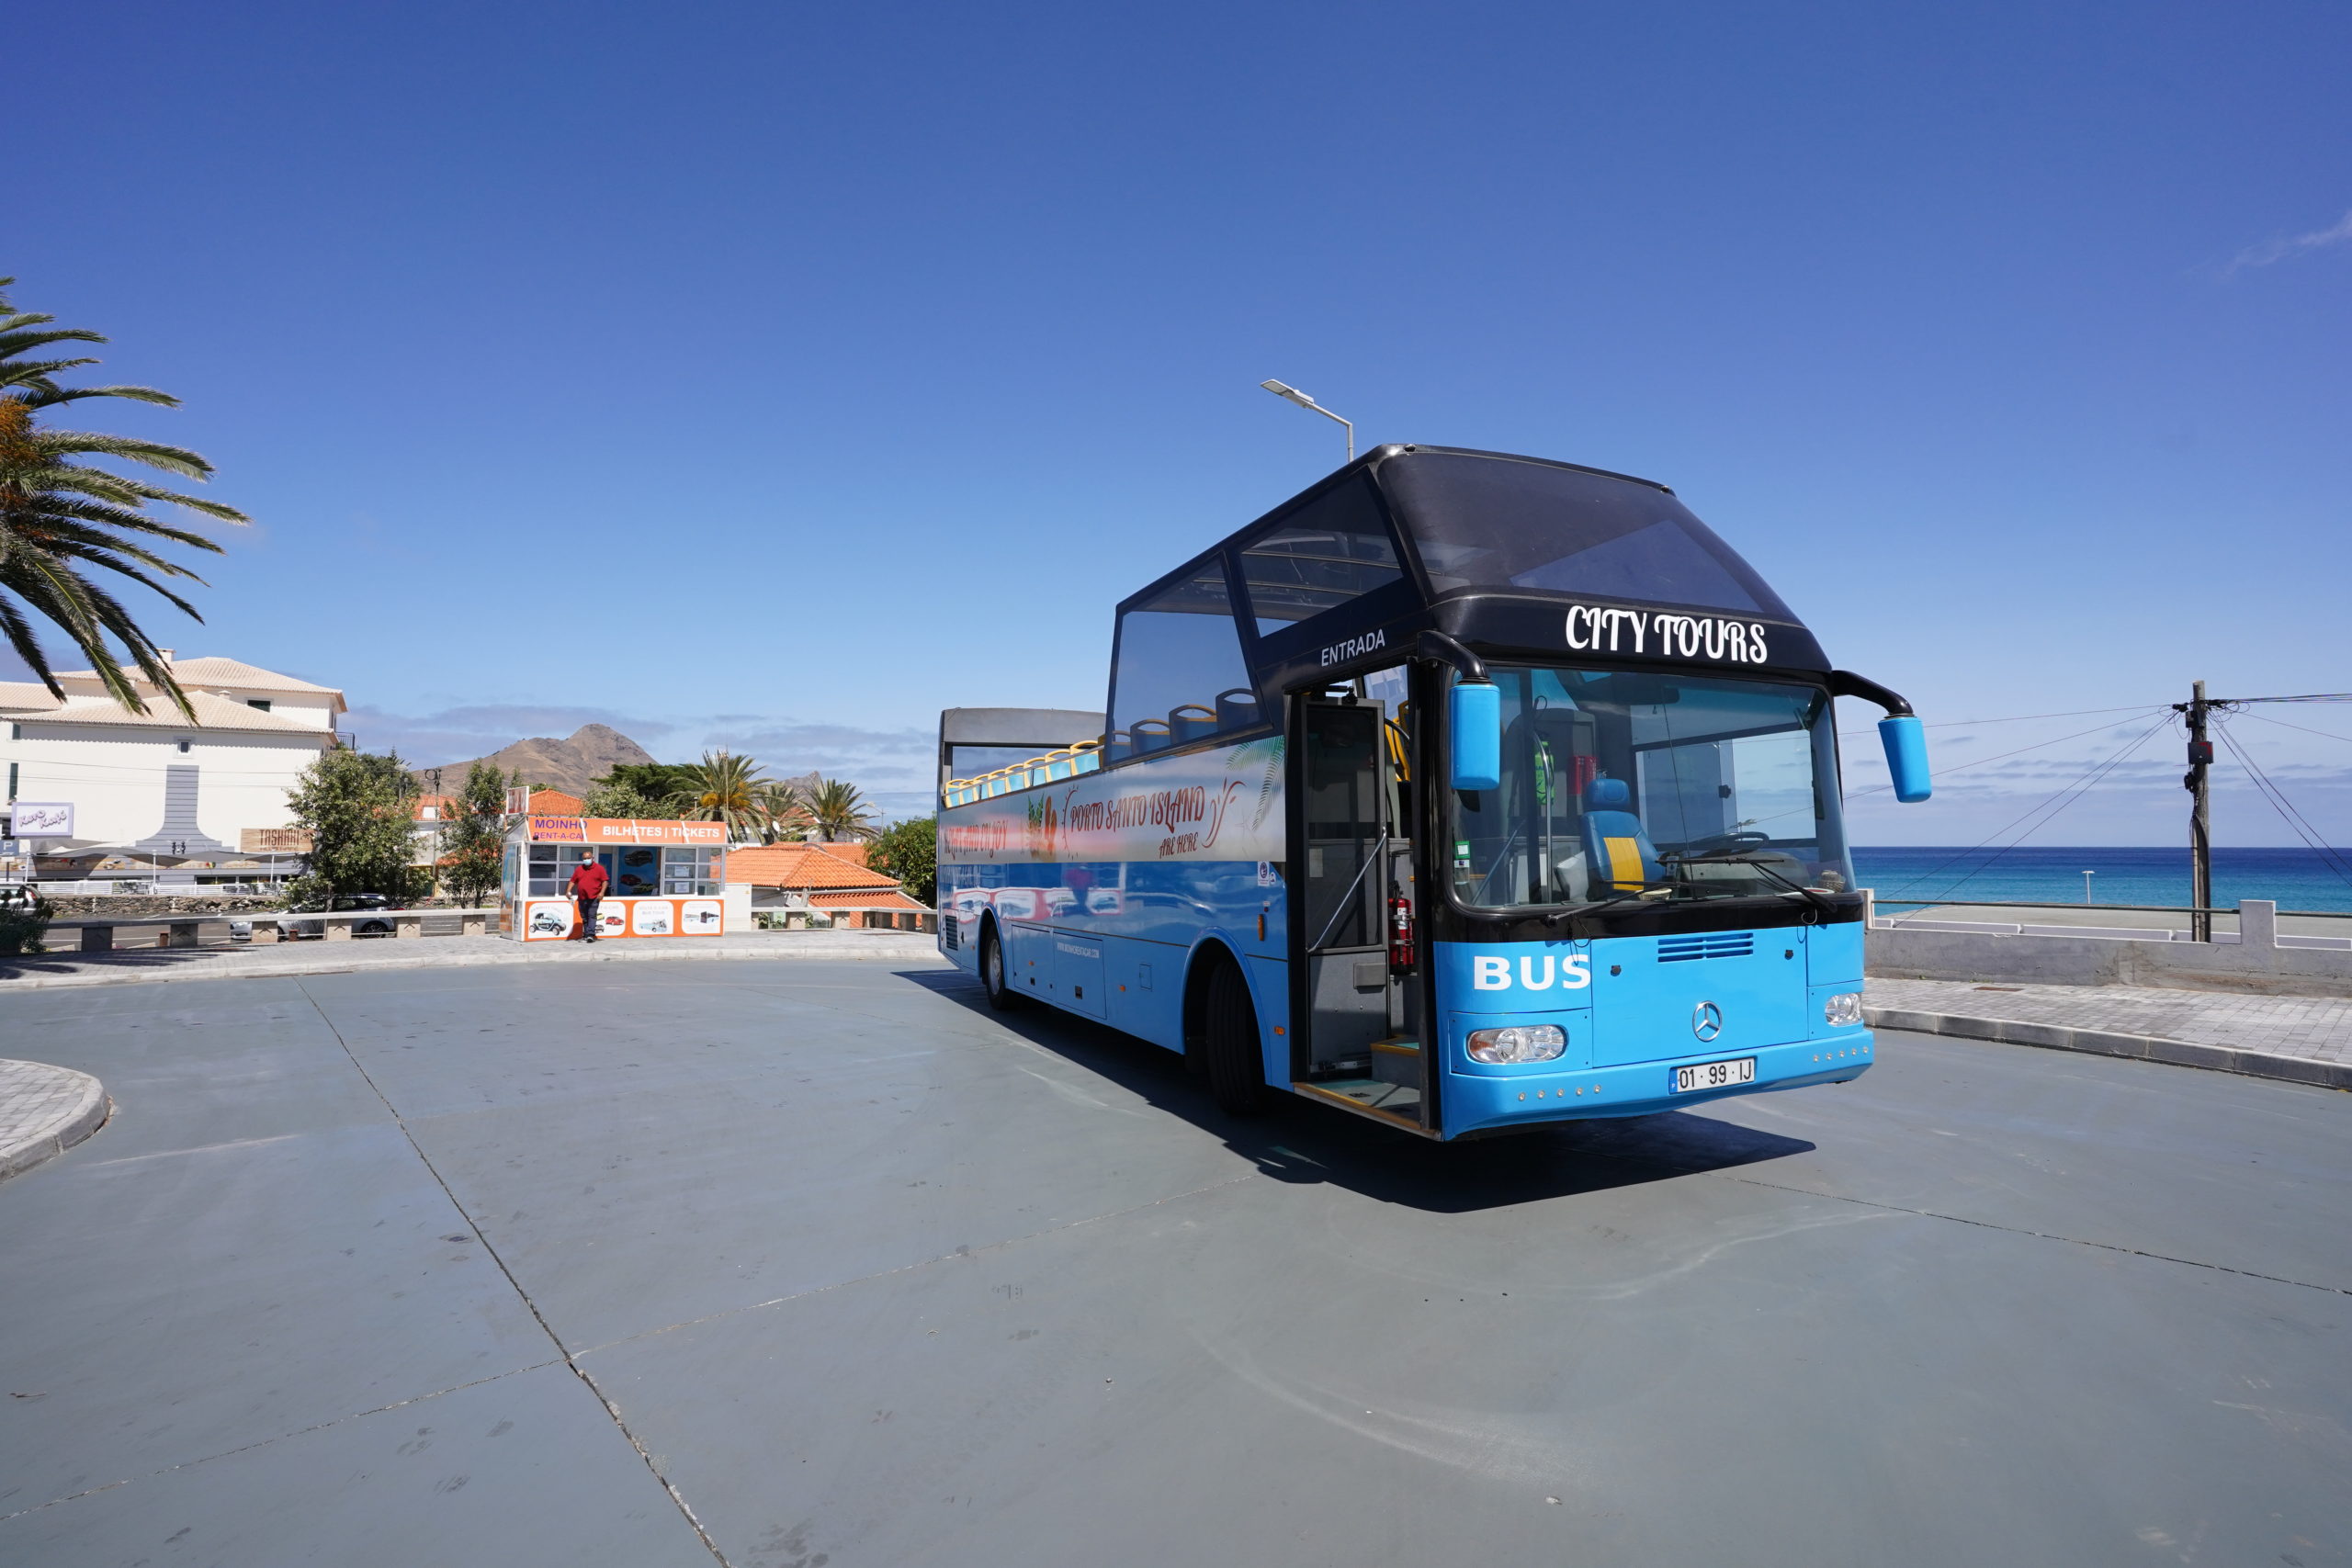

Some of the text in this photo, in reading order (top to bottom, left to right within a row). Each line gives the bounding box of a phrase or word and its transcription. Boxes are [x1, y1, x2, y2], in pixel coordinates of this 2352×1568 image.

[1321, 628, 1385, 667] ENTRADA
[1566, 605, 1768, 664] CITY TOURS
[535, 818, 588, 829] MOINHO
[1070, 785, 1205, 834] PORTO SANTO ISLAND
[4, 840, 13, 851] P
[603, 825, 662, 837] BILHETES
[672, 828, 720, 838] TICKETS
[1159, 831, 1198, 859] ARE HERE
[1474, 953, 1591, 991] BUS
